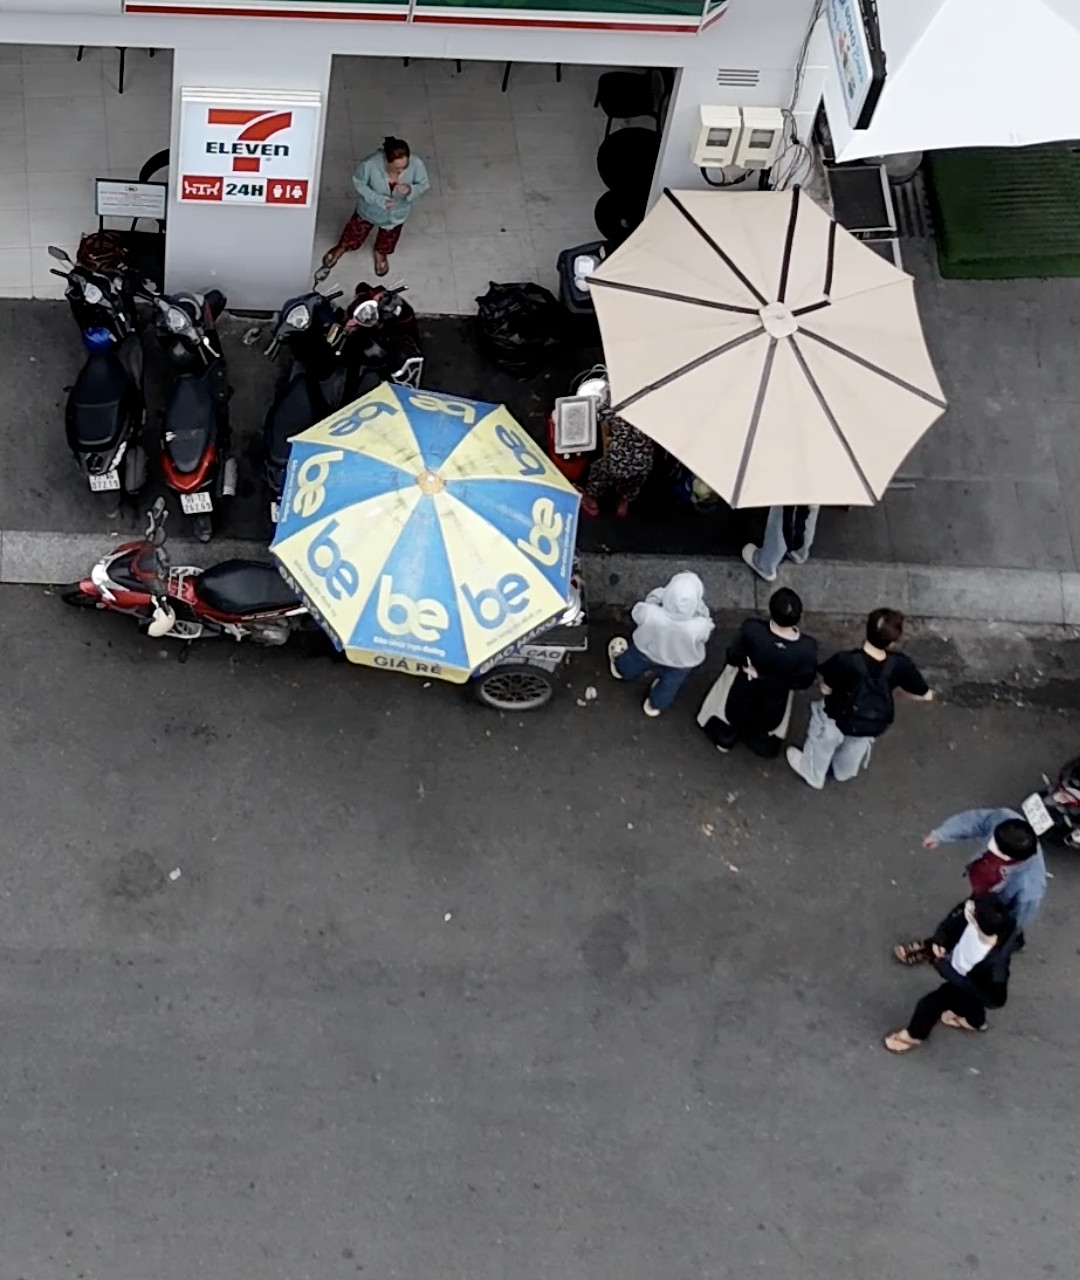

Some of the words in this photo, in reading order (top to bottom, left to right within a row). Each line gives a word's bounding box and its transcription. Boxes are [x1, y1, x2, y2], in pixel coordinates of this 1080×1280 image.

[208, 108, 292, 172] 7
[225, 183, 264, 197] 24H
[328, 401, 398, 437] be
[408, 395, 476, 424] be
[495, 424, 546, 476] be
[293, 451, 344, 518] be
[307, 518, 359, 601] be
[517, 497, 562, 566] be
[377, 574, 449, 642] be
[460, 573, 531, 630] be
[374, 655, 409, 671] GIÁ
